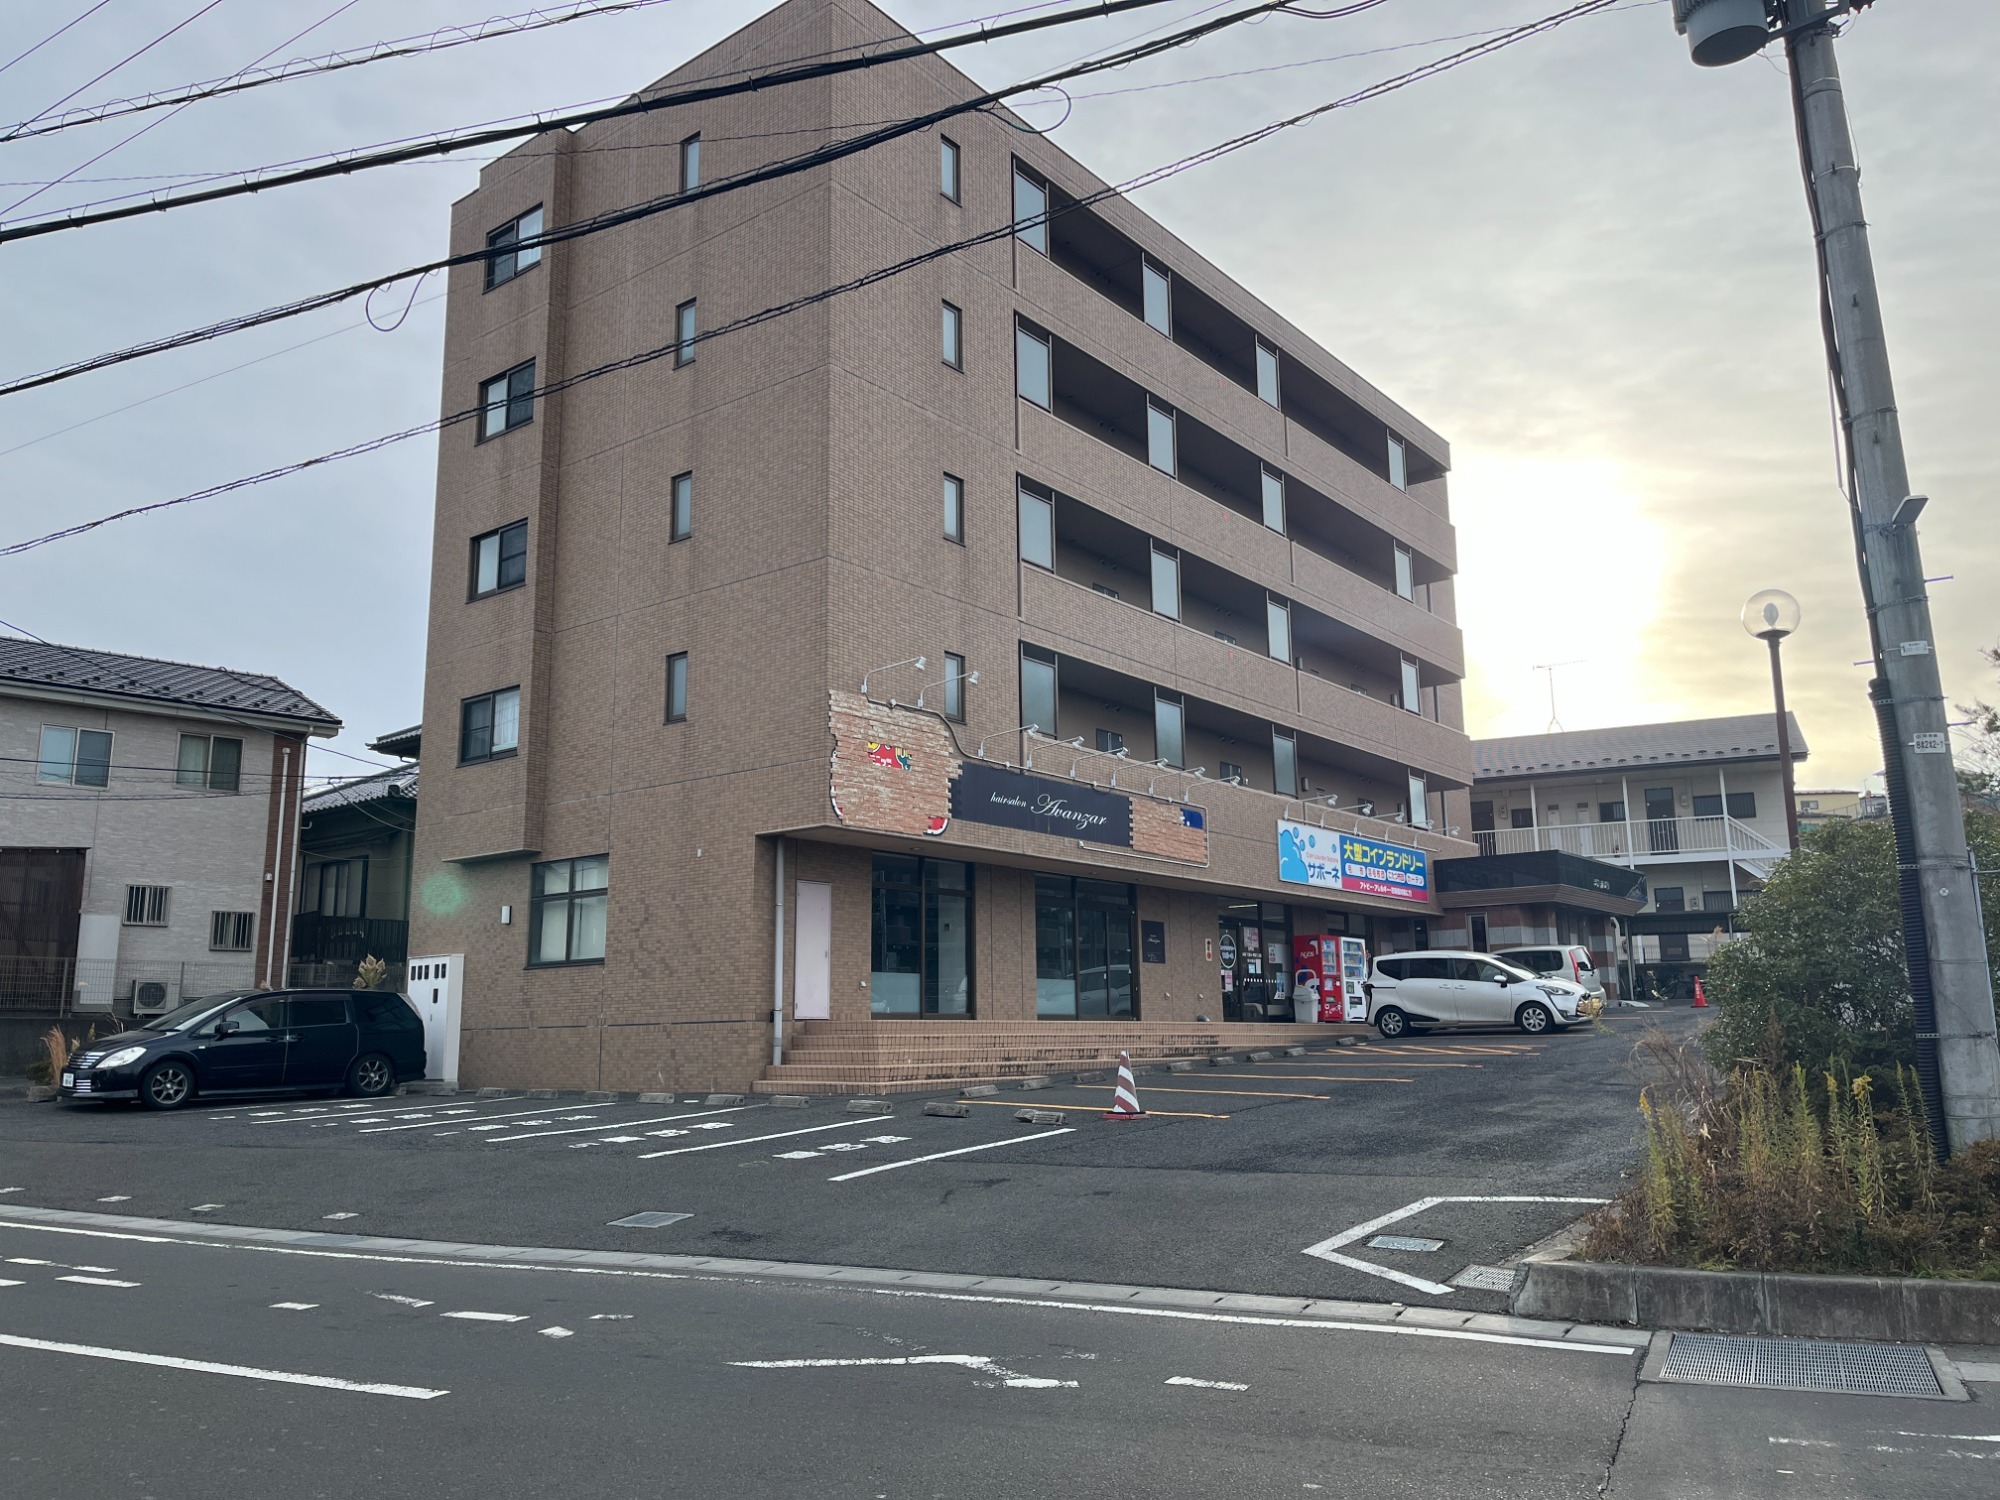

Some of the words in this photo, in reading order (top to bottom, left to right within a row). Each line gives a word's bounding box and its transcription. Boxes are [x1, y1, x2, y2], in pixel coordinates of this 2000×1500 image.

[1031, 793, 1108, 830] Avanzar
[1343, 840, 1424, 872] 大型コインランドリー
